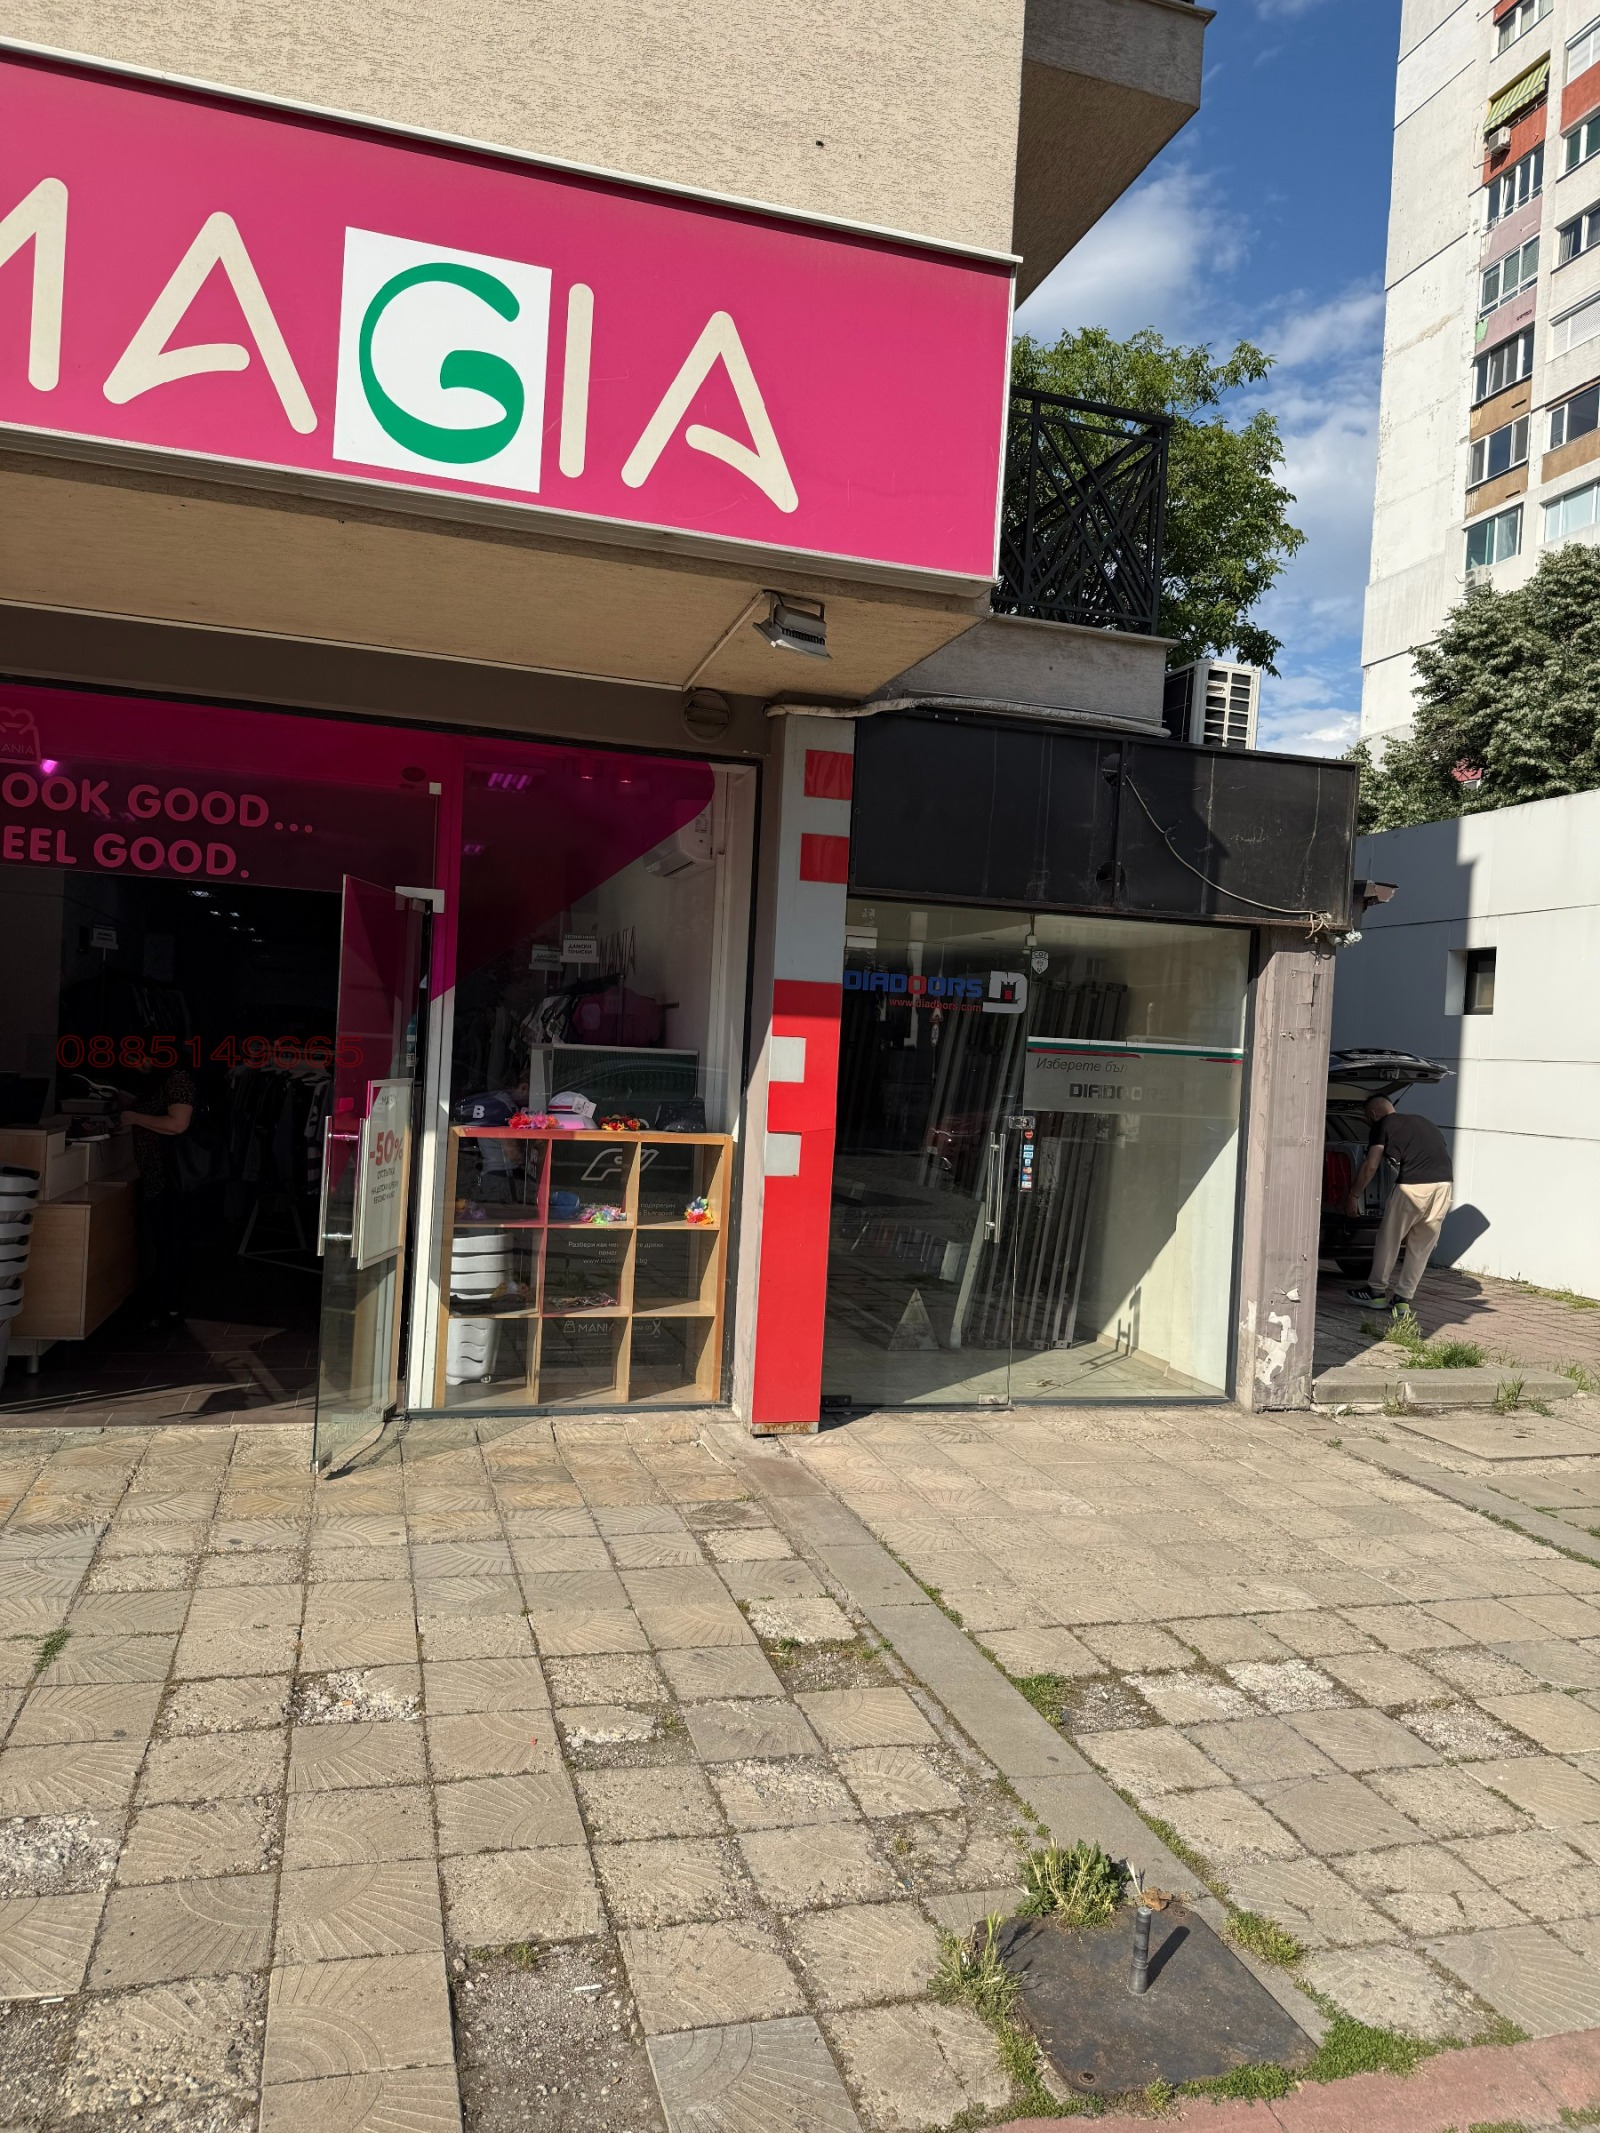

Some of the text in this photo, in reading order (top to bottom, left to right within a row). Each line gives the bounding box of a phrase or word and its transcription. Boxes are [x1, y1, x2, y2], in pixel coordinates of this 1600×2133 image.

[1, 771, 111, 817] OOK
[2, 825, 251, 879] EEL GOOD.
[843, 969, 983, 998] DIADOORS
[55, 1034, 365, 1069] 0885149665
[1036, 1057, 1101, 1074] Изберете
[369, 1129, 404, 1167] -50%
[568, 1240, 596, 1250] Разбери
